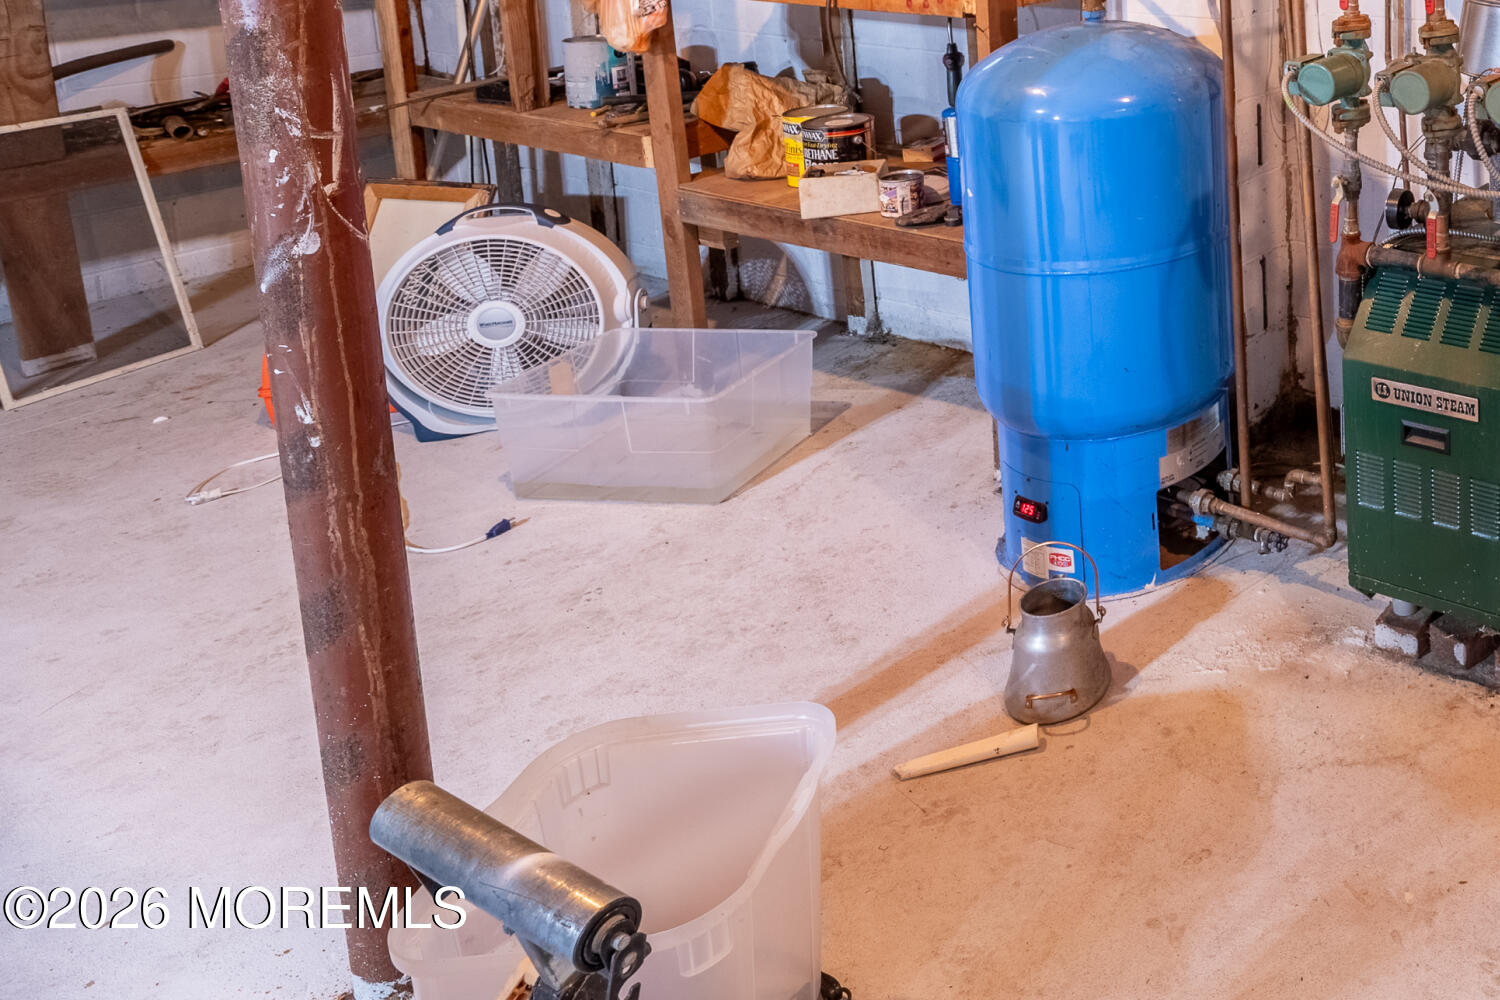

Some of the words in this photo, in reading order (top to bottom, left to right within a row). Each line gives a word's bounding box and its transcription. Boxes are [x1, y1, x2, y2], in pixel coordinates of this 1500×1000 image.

[1393, 388, 1432, 407] UNION
[1436, 396, 1476, 416] STEAM
[1021, 503, 1035, 516] 125
